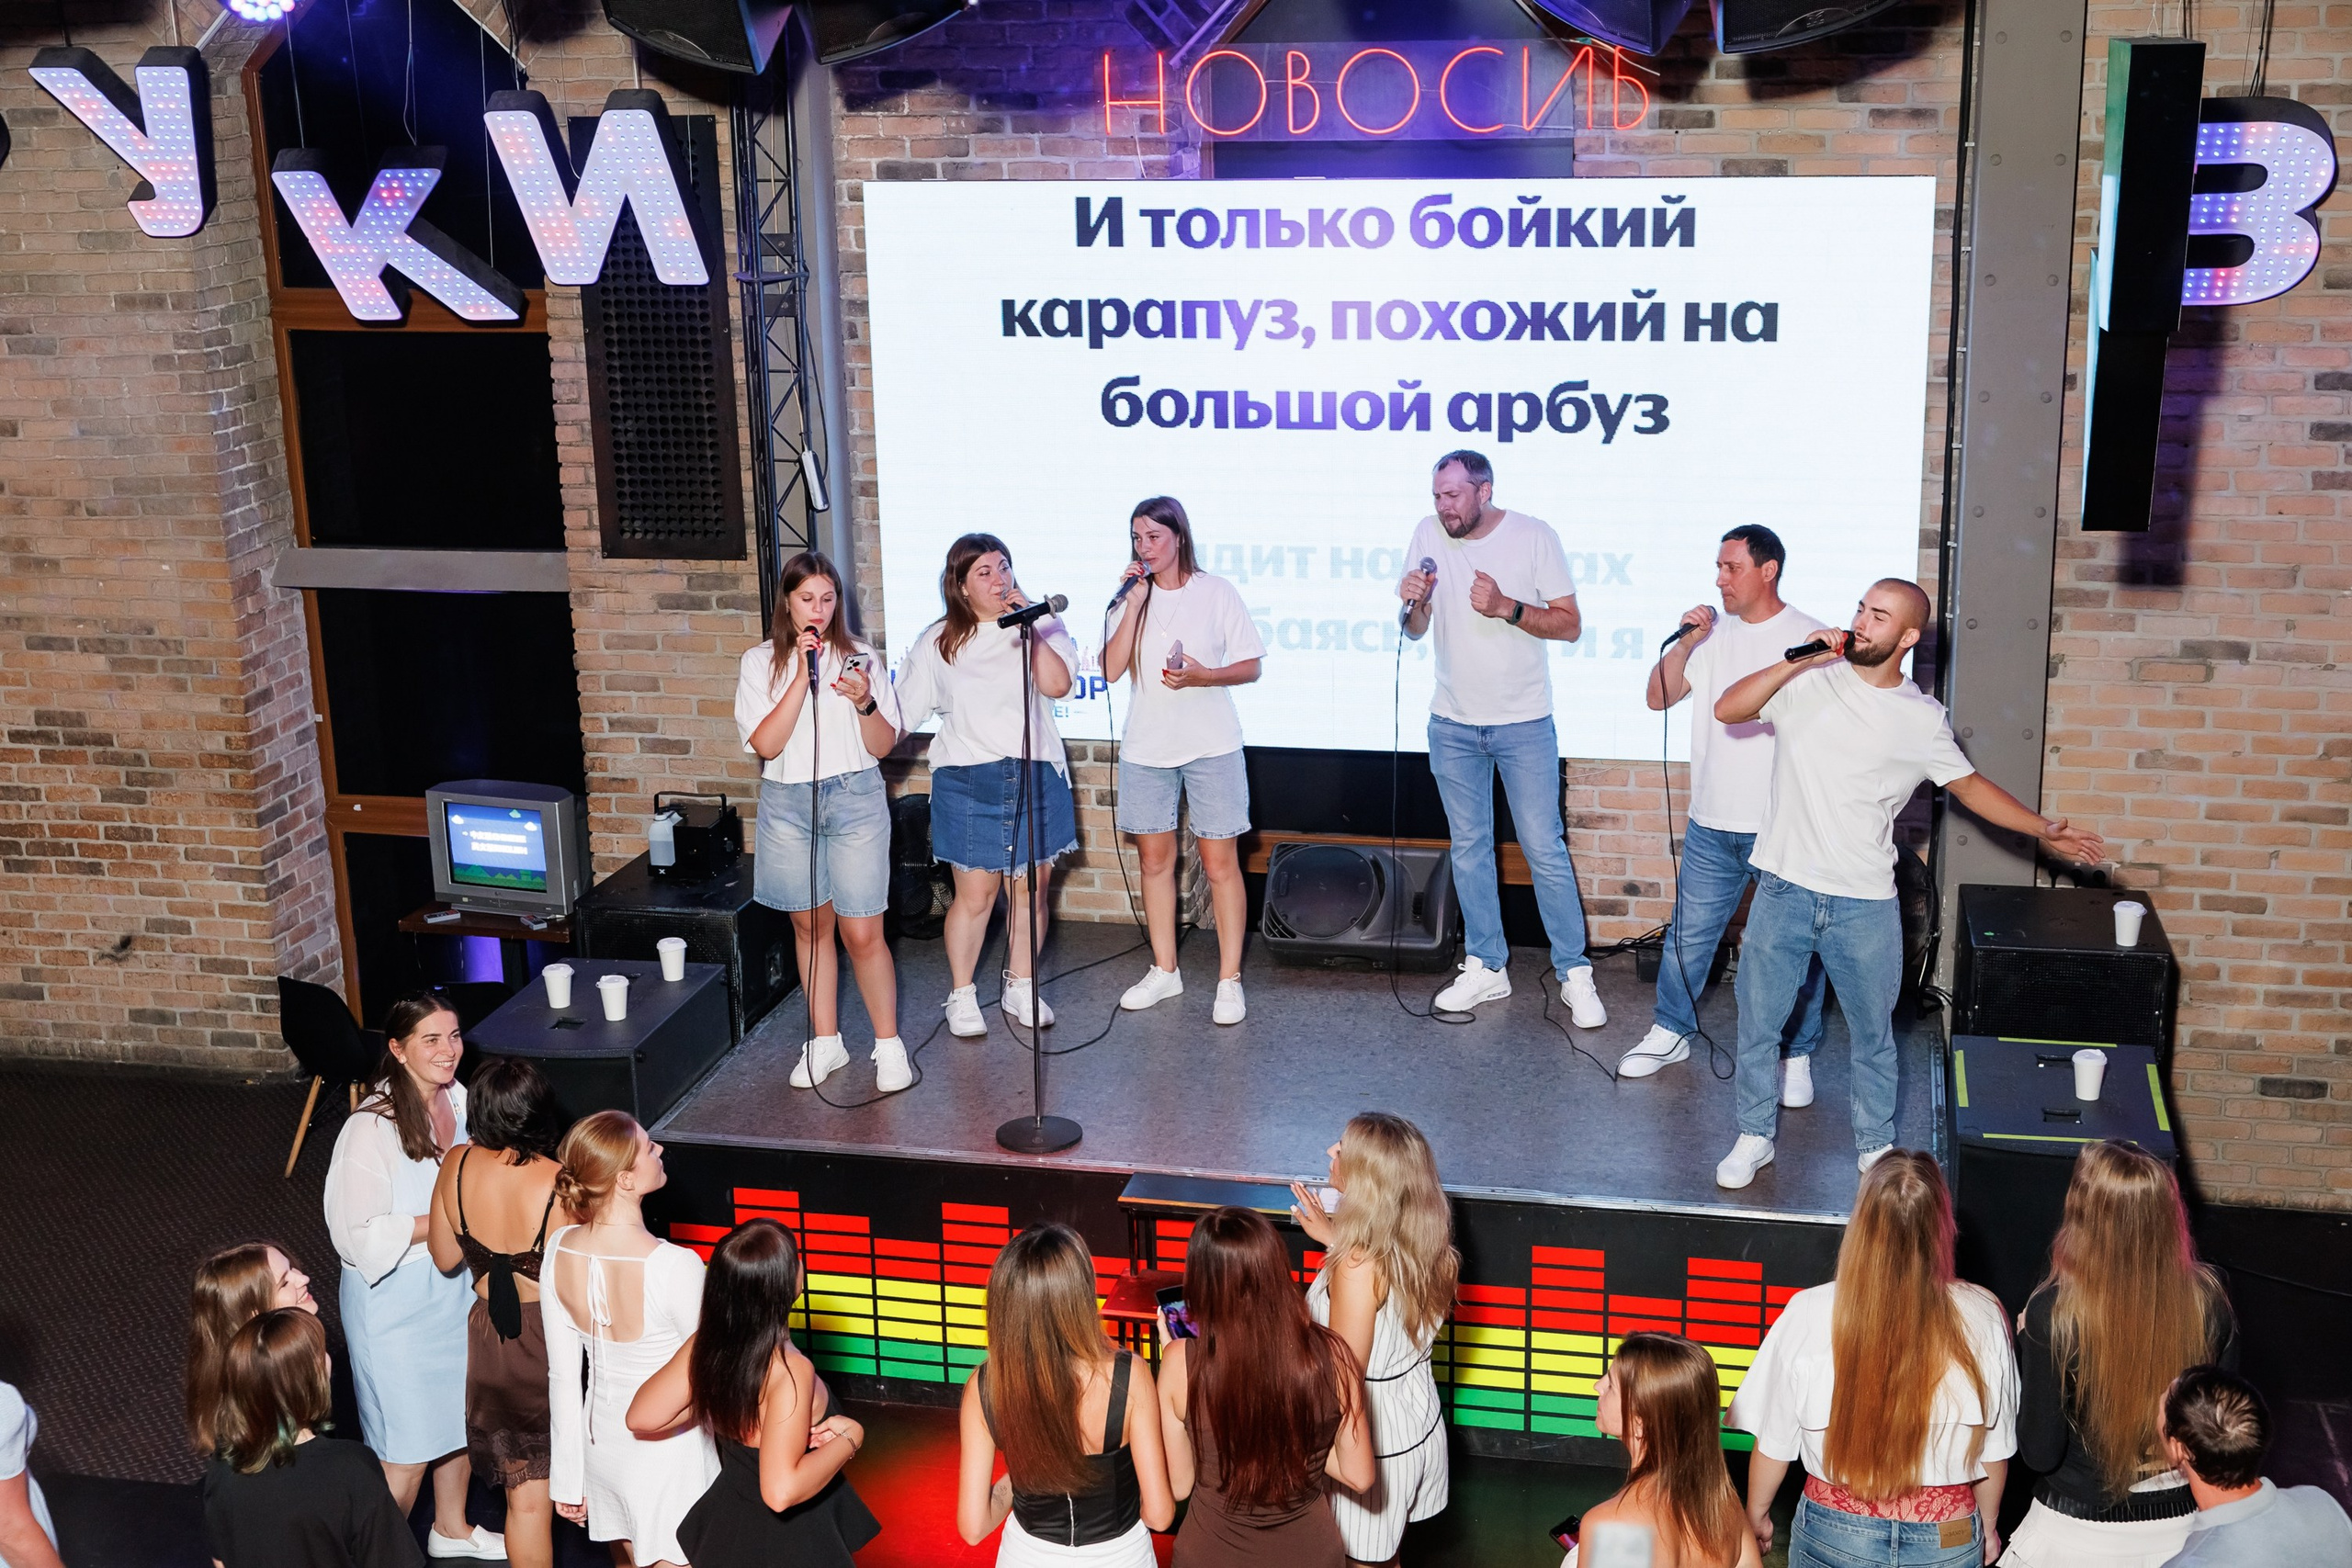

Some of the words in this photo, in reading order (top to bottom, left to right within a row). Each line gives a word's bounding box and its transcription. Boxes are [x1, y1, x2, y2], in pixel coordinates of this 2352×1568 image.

[1104, 46, 1650, 135] НОВОСИБ
[28, 46, 711, 323] УКИ
[1075, 196, 1125, 248] И
[1138, 207, 1395, 249] только
[1409, 193, 1696, 249] бойкий
[1001, 297, 1317, 351] карапуз,
[1331, 288, 1666, 342] похожий
[1683, 300, 1779, 343] на
[1101, 375, 1431, 431] большой
[1447, 379, 1670, 445] арбуз
[1194, 544, 1317, 584] дит
[1611, 627, 1644, 660] я
